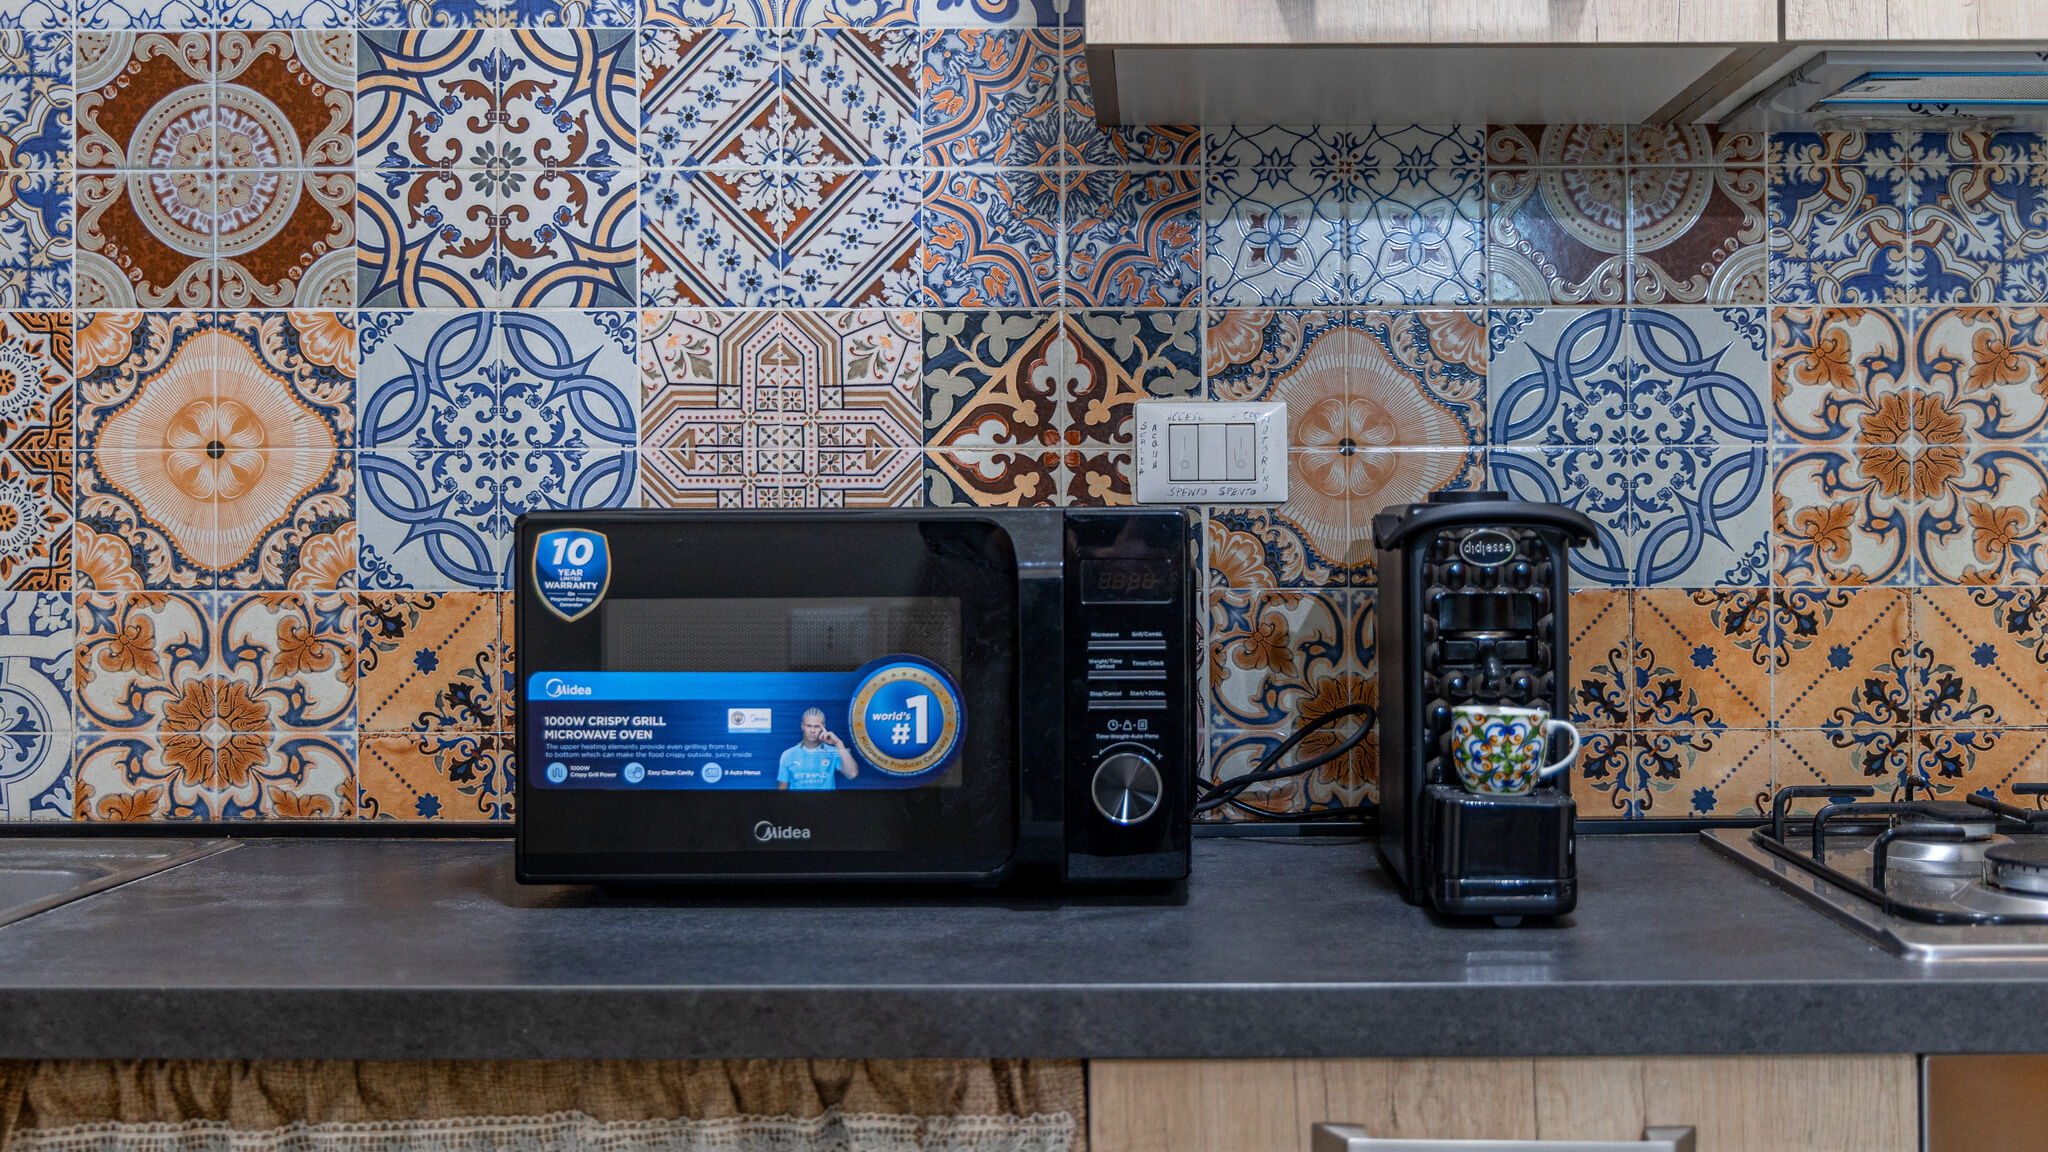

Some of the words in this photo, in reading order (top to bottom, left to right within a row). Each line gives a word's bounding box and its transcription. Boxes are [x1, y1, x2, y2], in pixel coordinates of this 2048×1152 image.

[1167, 488, 1208, 497] SPENTO
[1218, 488, 1257, 496] SPENTO
[552, 537, 594, 566] 10
[558, 568, 584, 576] YEAR
[544, 582, 598, 590] WARRANTY
[546, 678, 592, 698] Midea
[872, 712, 911, 720] world's
[544, 716, 586, 726] 1000W
[588, 716, 630, 726] CRISPY
[632, 716, 666, 726] GRILL
[544, 730, 617, 740] MICROWAVE
[620, 730, 653, 740] OVEN
[582, 743, 606, 752] heating
[640, 743, 666, 752] provide
[684, 743, 707, 752] grilling
[861, 736, 889, 765] Microwave
[924, 736, 950, 763] Company
[716, 752, 730, 760] juicy
[754, 820, 810, 840] Midea
